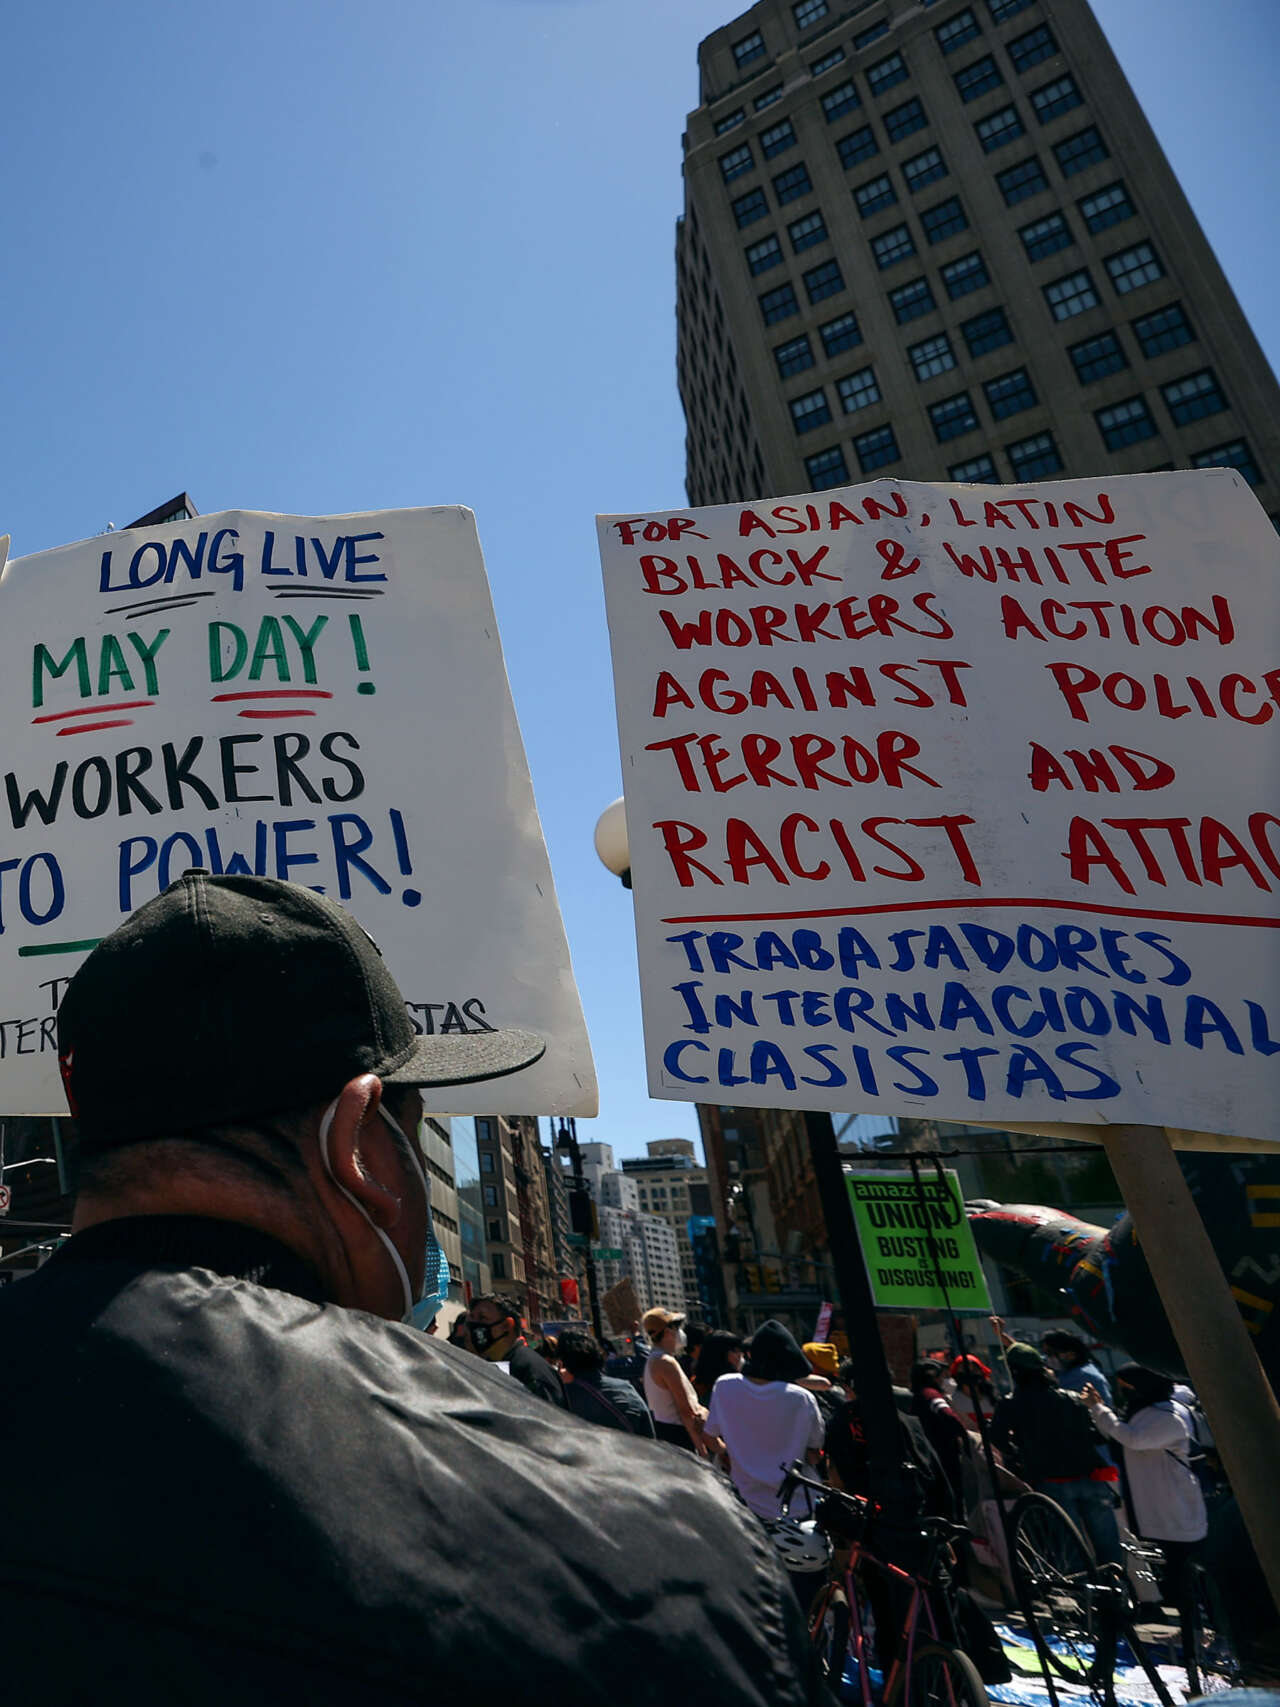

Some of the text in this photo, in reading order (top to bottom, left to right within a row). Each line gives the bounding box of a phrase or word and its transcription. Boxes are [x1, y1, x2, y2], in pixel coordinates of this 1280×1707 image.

[614, 491, 1116, 545] FOR ASIAN, LATIN
[99, 528, 389, 593] LONG LIVE
[638, 534, 1153, 596] BLACK & WHITE
[658, 592, 1235, 650] WORKERS ACTION
[32, 613, 377, 708] MAY DAY!
[652, 658, 974, 718] AGAINST
[4, 731, 366, 829] WORKERS
[644, 730, 1176, 794] TERROR AND
[118, 808, 422, 913] POWER!
[652, 812, 982, 888] RACIST
[666, 922, 1193, 987] TRABAJADORES
[662, 1039, 1122, 1103] CLASISTAS
